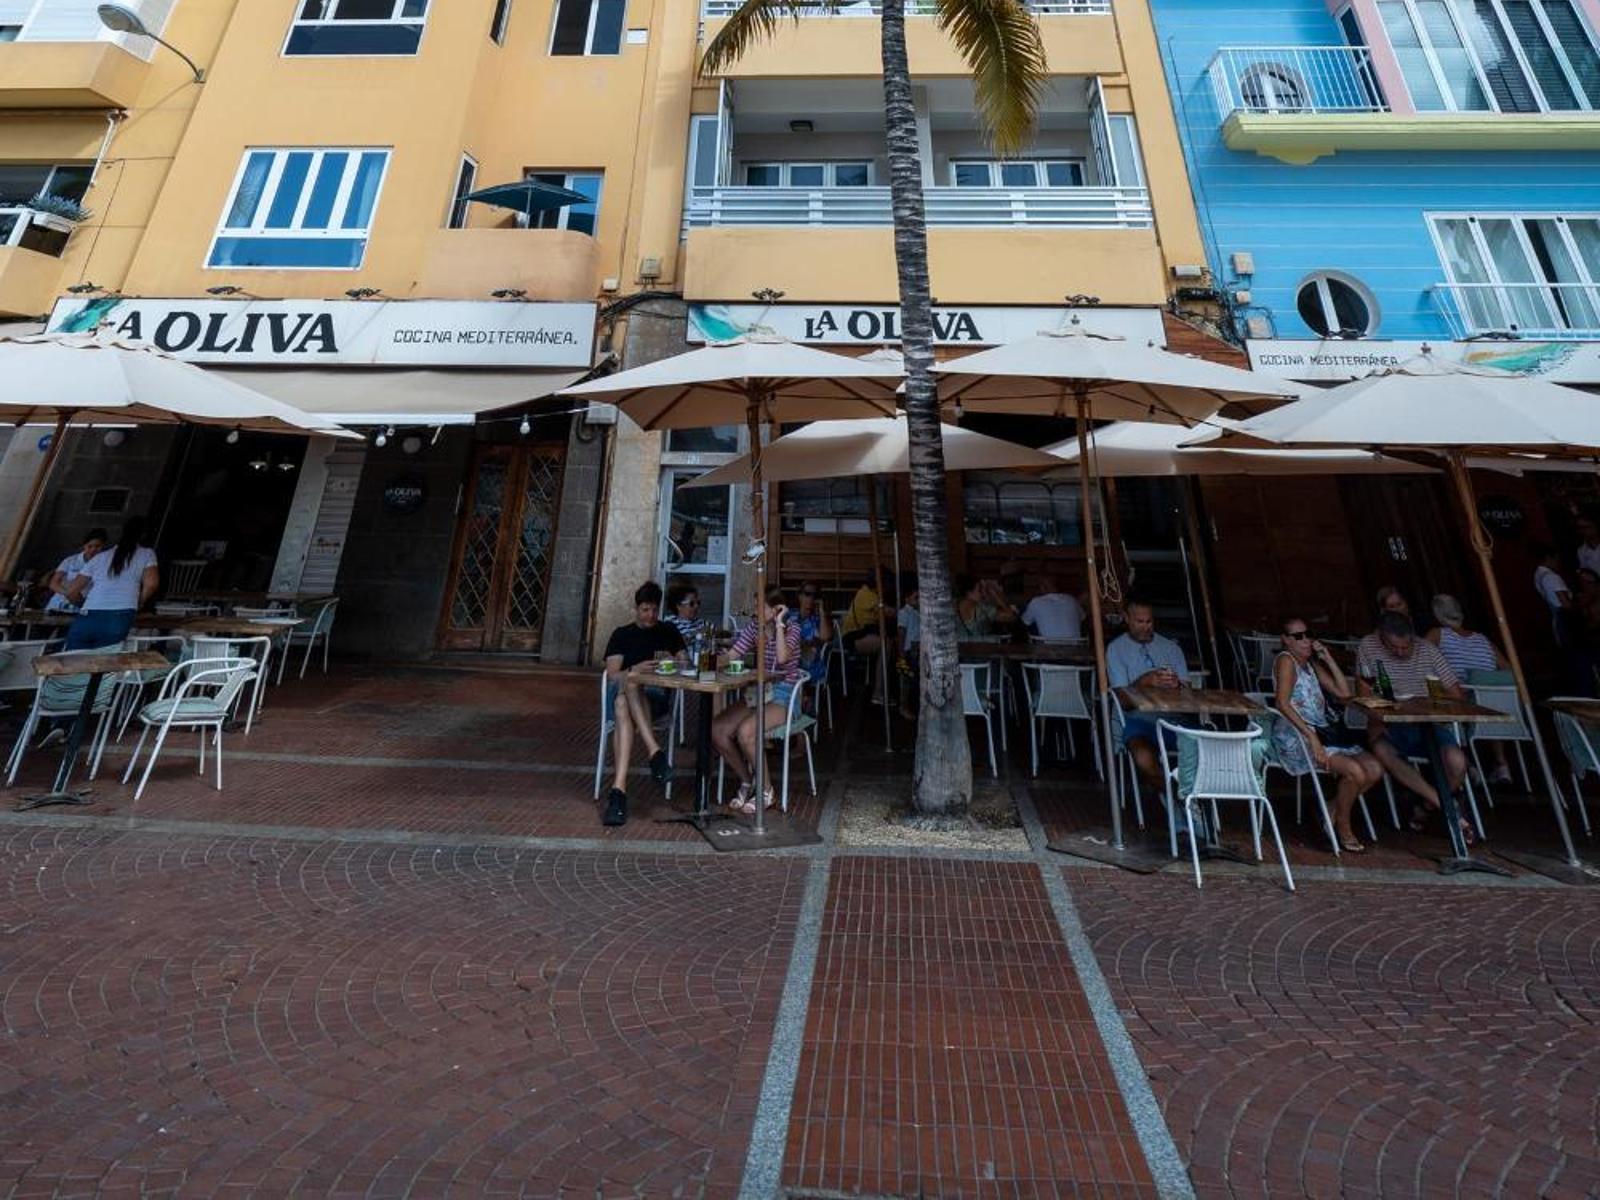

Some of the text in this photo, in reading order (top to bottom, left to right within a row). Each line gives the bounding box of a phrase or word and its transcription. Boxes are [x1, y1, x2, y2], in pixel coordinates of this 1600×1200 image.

[106, 310, 339, 354] A OLIVA
[393, 328, 578, 345] COCINA MEDITERRÁNEA.
[805, 310, 983, 341] LA OLVA
[1259, 354, 1305, 366] COCINA
